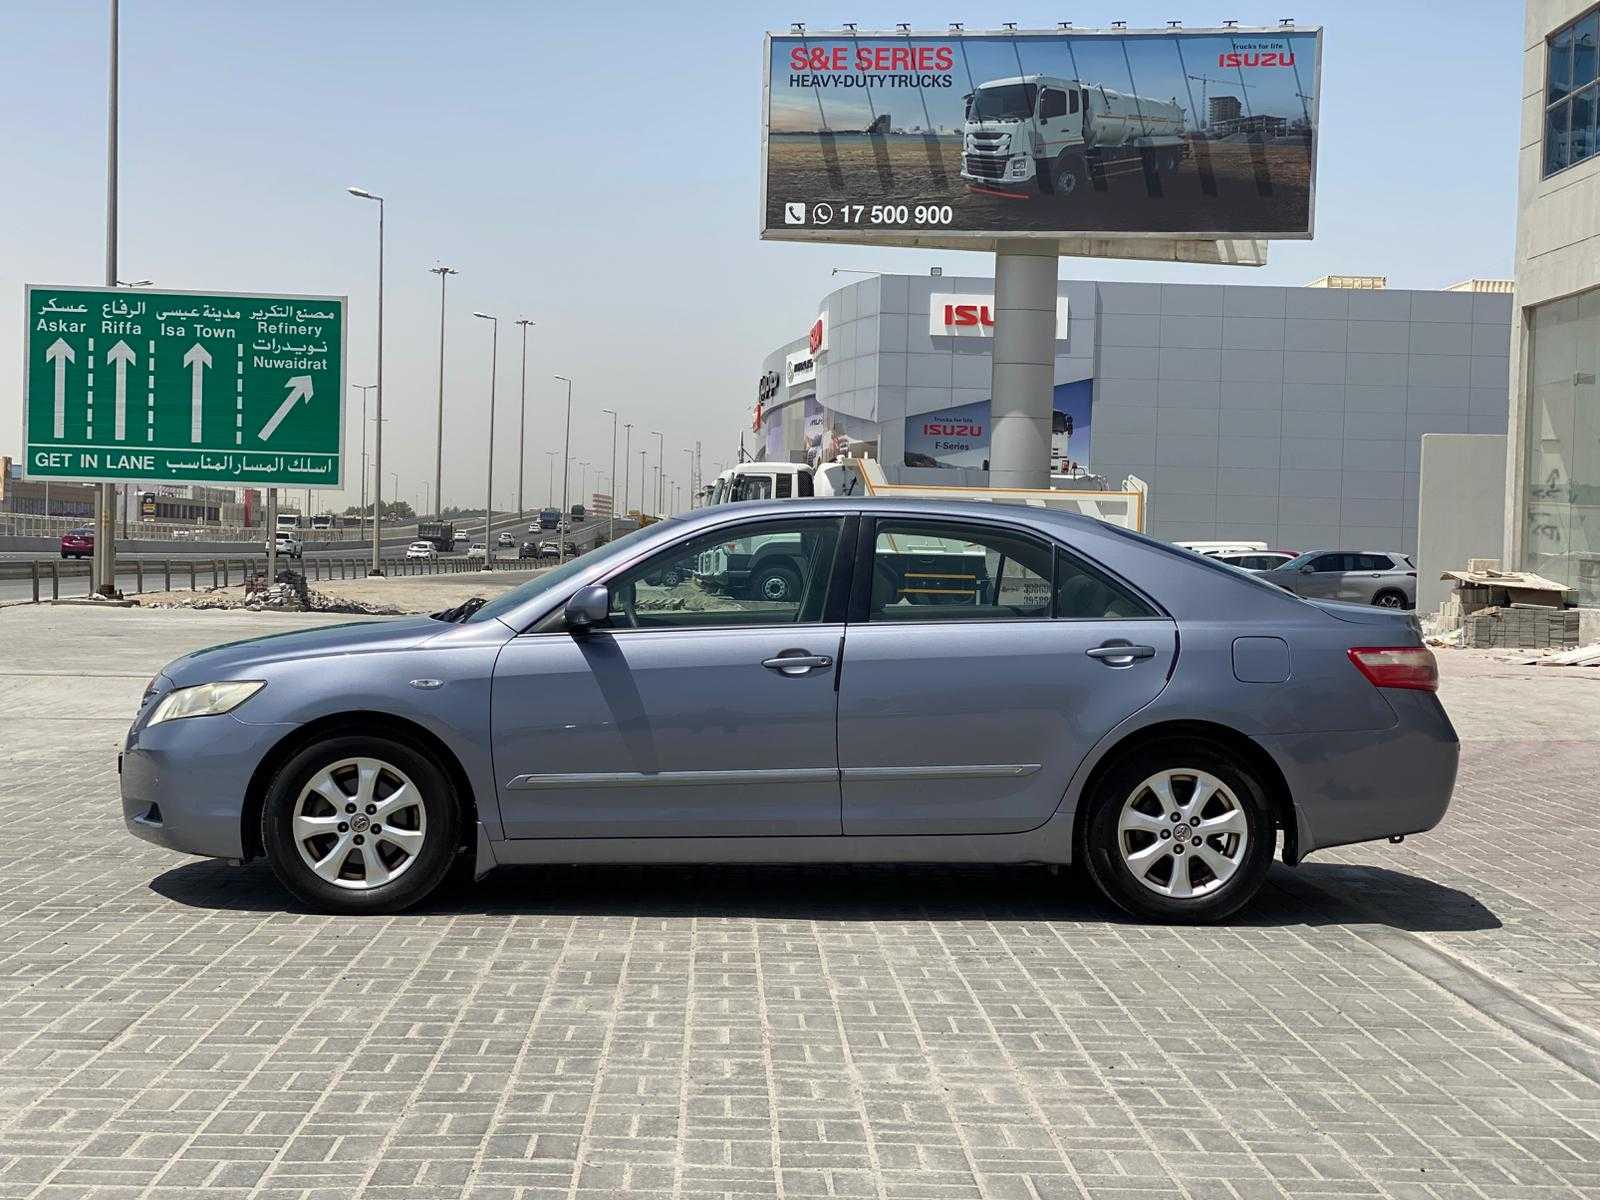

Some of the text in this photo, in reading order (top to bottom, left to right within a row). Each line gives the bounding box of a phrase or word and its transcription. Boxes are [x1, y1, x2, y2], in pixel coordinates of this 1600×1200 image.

[1270, 42, 1283, 50] life
[790, 47, 953, 71] S&E SERIES
[1218, 52, 1296, 68] ISUZU
[789, 74, 952, 88] HEAVY-DUTY TRUCKS
[840, 205, 953, 225] 17 500 900
[38, 298, 88, 315] عسكر
[102, 299, 146, 318] الرفاع
[203, 304, 241, 322] مدينة
[248, 304, 335, 323] مصنع التكرير
[944, 305, 995, 326] ISU
[36, 318, 87, 333] Askar
[101, 320, 142, 335] Riffa
[161, 323, 236, 338] Isa Town
[257, 321, 322, 338] Refinery
[253, 355, 328, 371] Nuwaidrat
[923, 424, 982, 437] ISUZU
[935, 441, 970, 451] F-Series
[35, 452, 155, 470] GET IN LANE
[287, 457, 332, 473] اسلك
